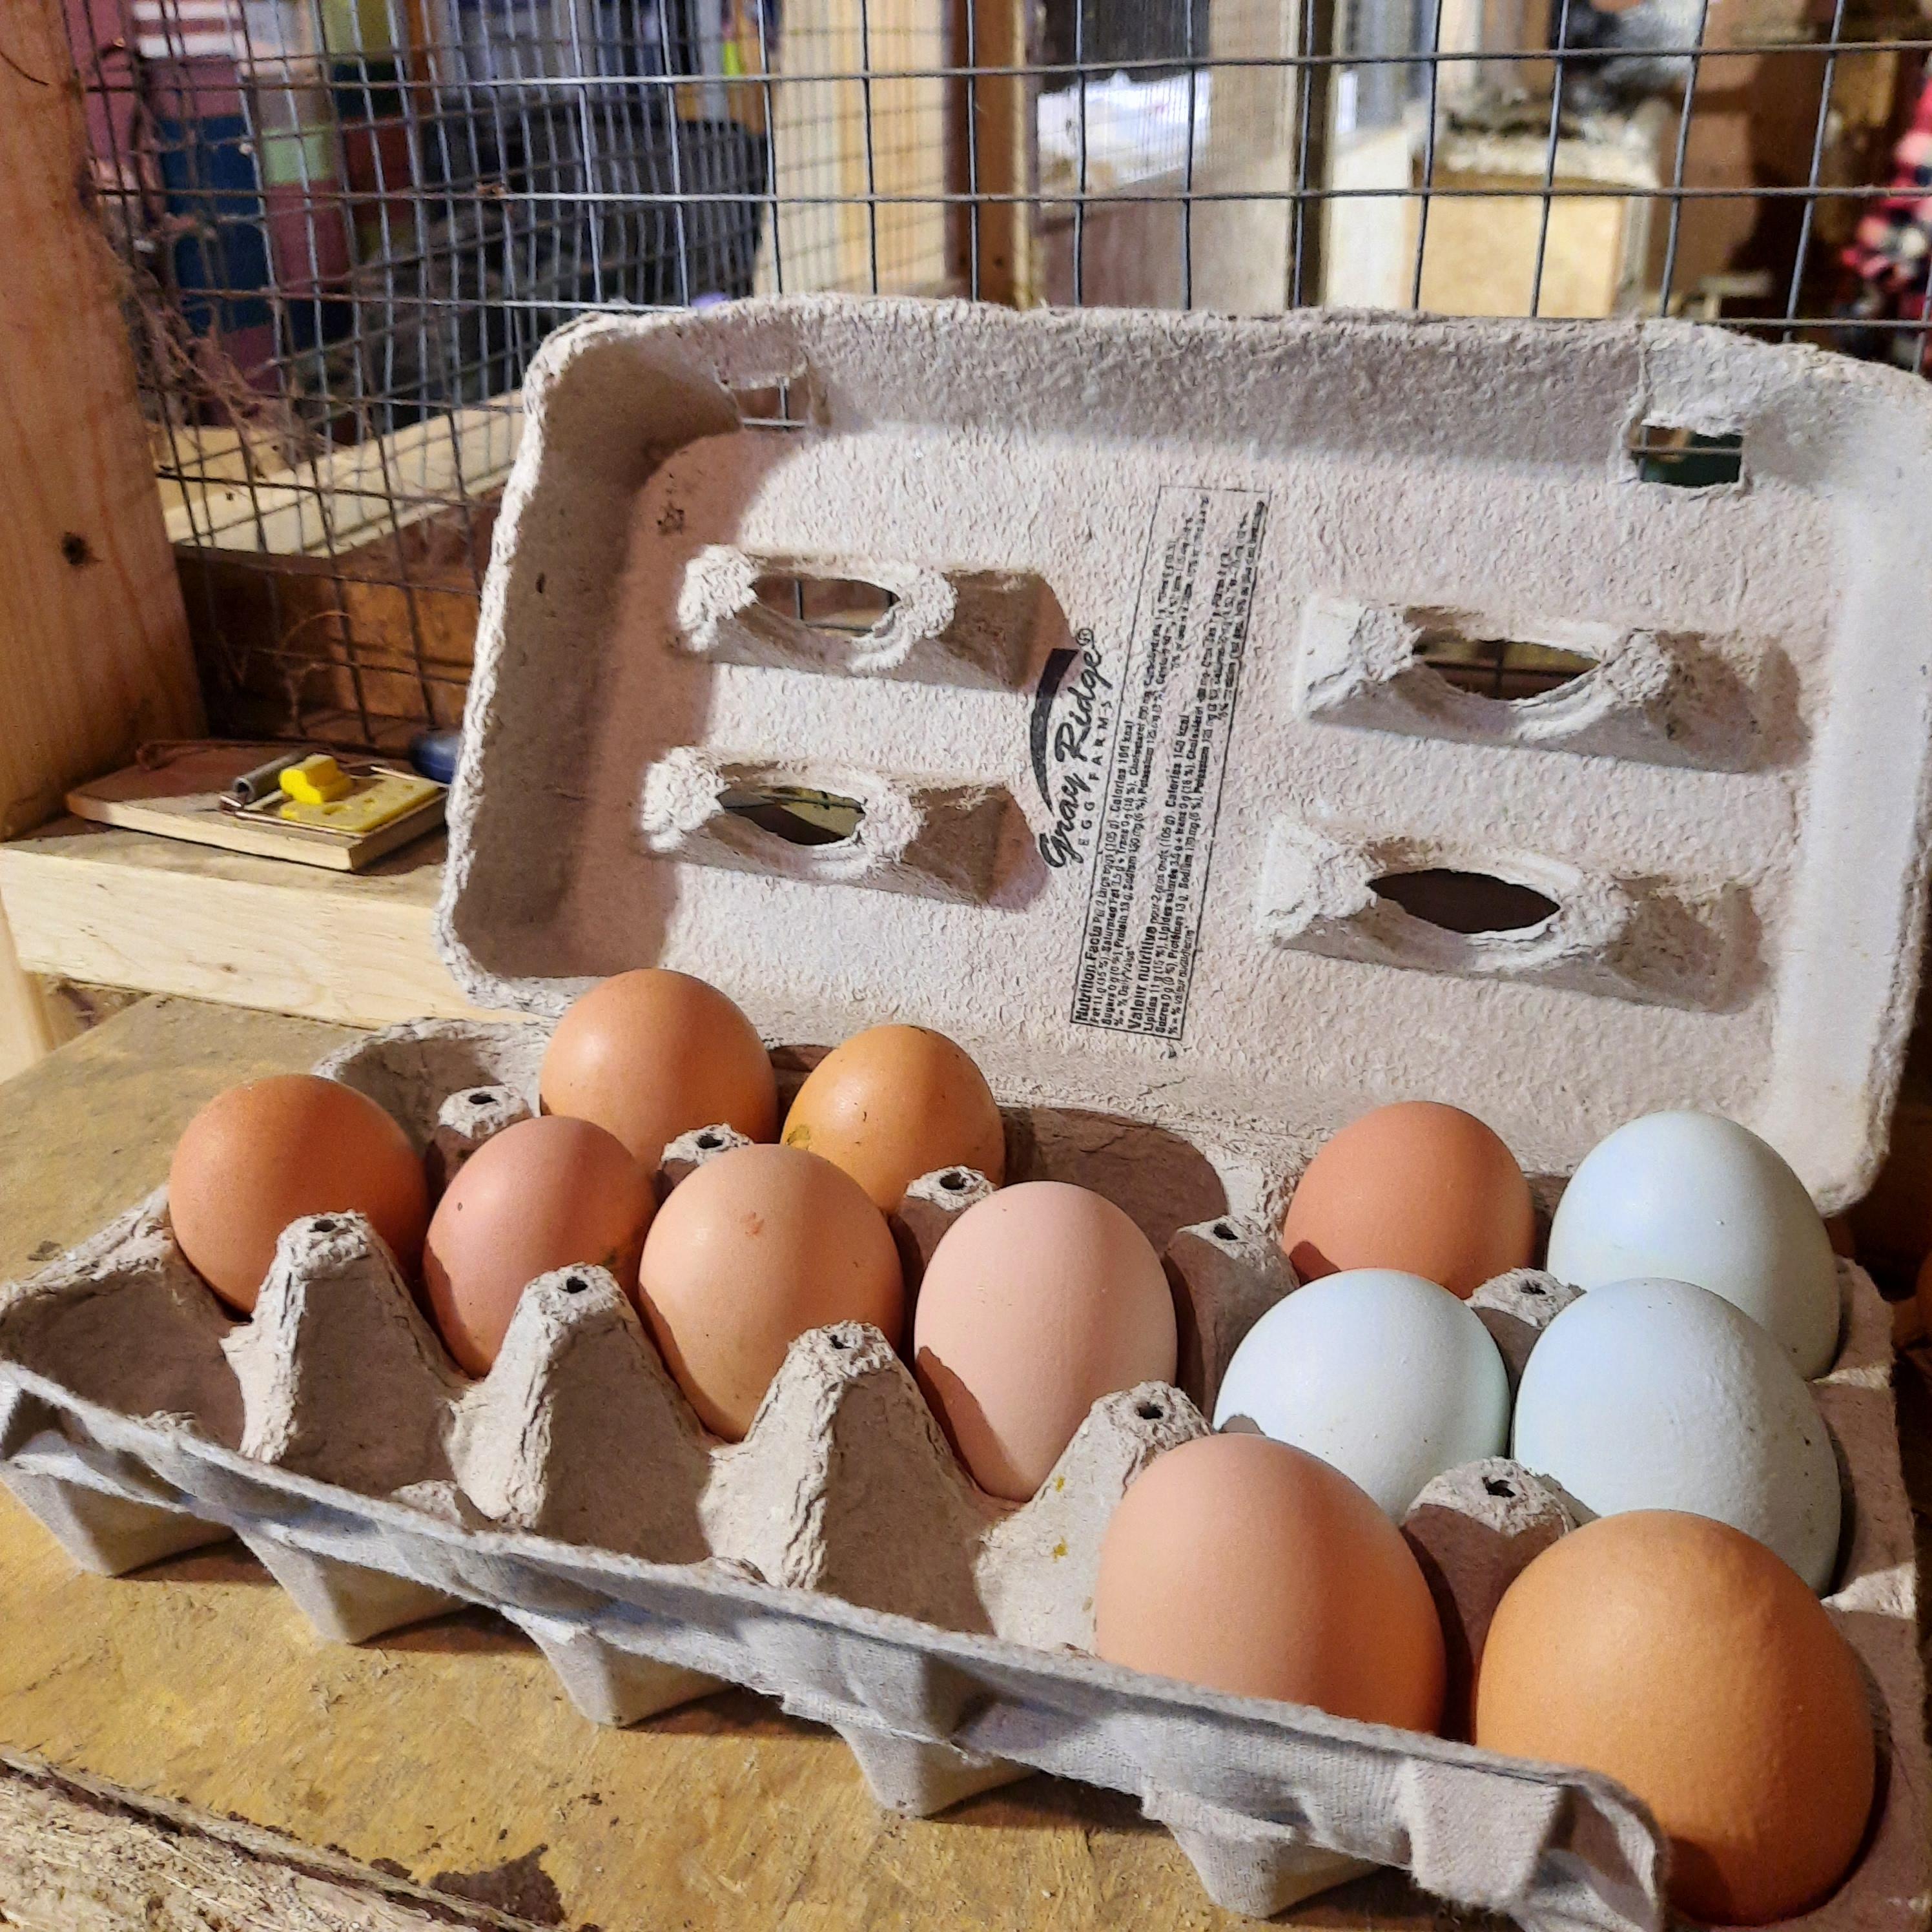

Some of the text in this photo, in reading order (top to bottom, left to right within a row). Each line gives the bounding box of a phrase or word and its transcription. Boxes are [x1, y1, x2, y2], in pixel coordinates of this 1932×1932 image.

[1040, 773, 1091, 868] Gray
[1078, 701, 1113, 845] EGG FARMS
[1074, 964, 1096, 1021] Nutrition
